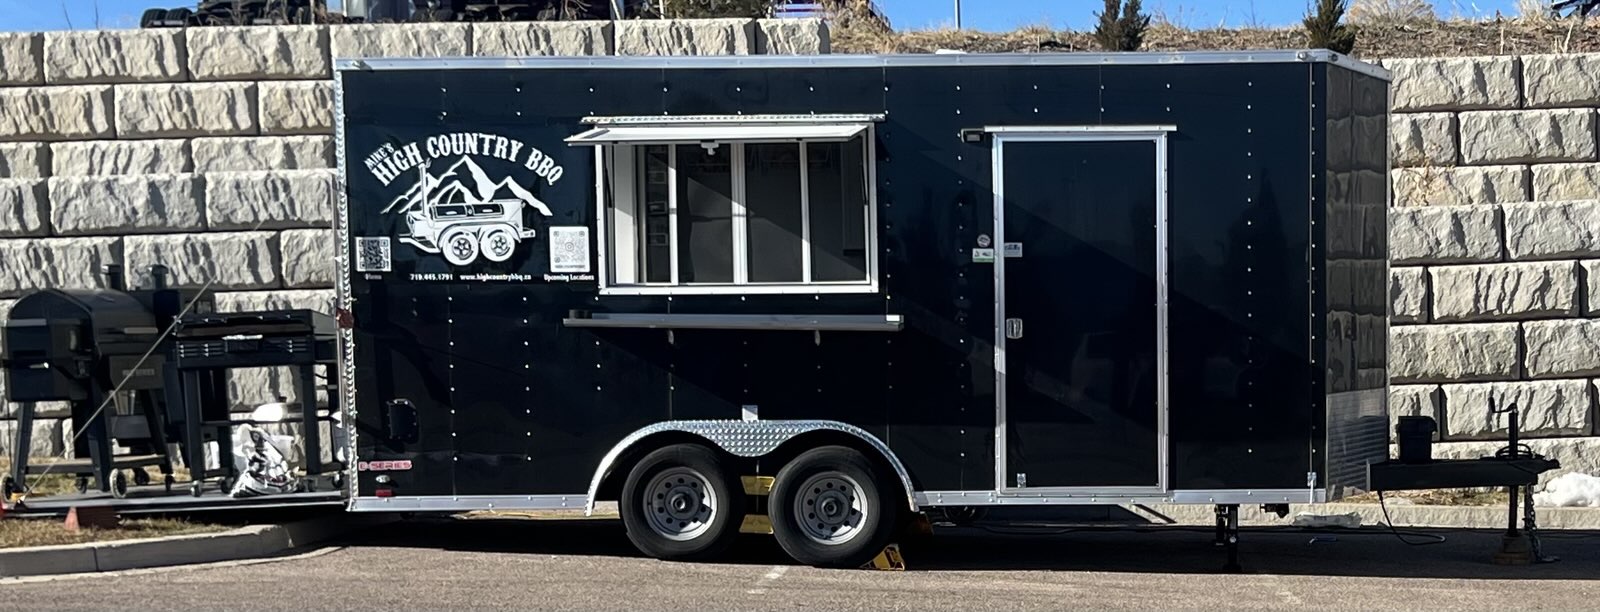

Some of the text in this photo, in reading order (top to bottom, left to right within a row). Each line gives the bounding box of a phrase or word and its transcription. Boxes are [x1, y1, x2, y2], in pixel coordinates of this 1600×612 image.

[364, 142, 394, 171] MIKE'S
[371, 132, 563, 187] HIGH COUNTRY BBQ
[544, 273, 594, 282] Upcoming Locations
